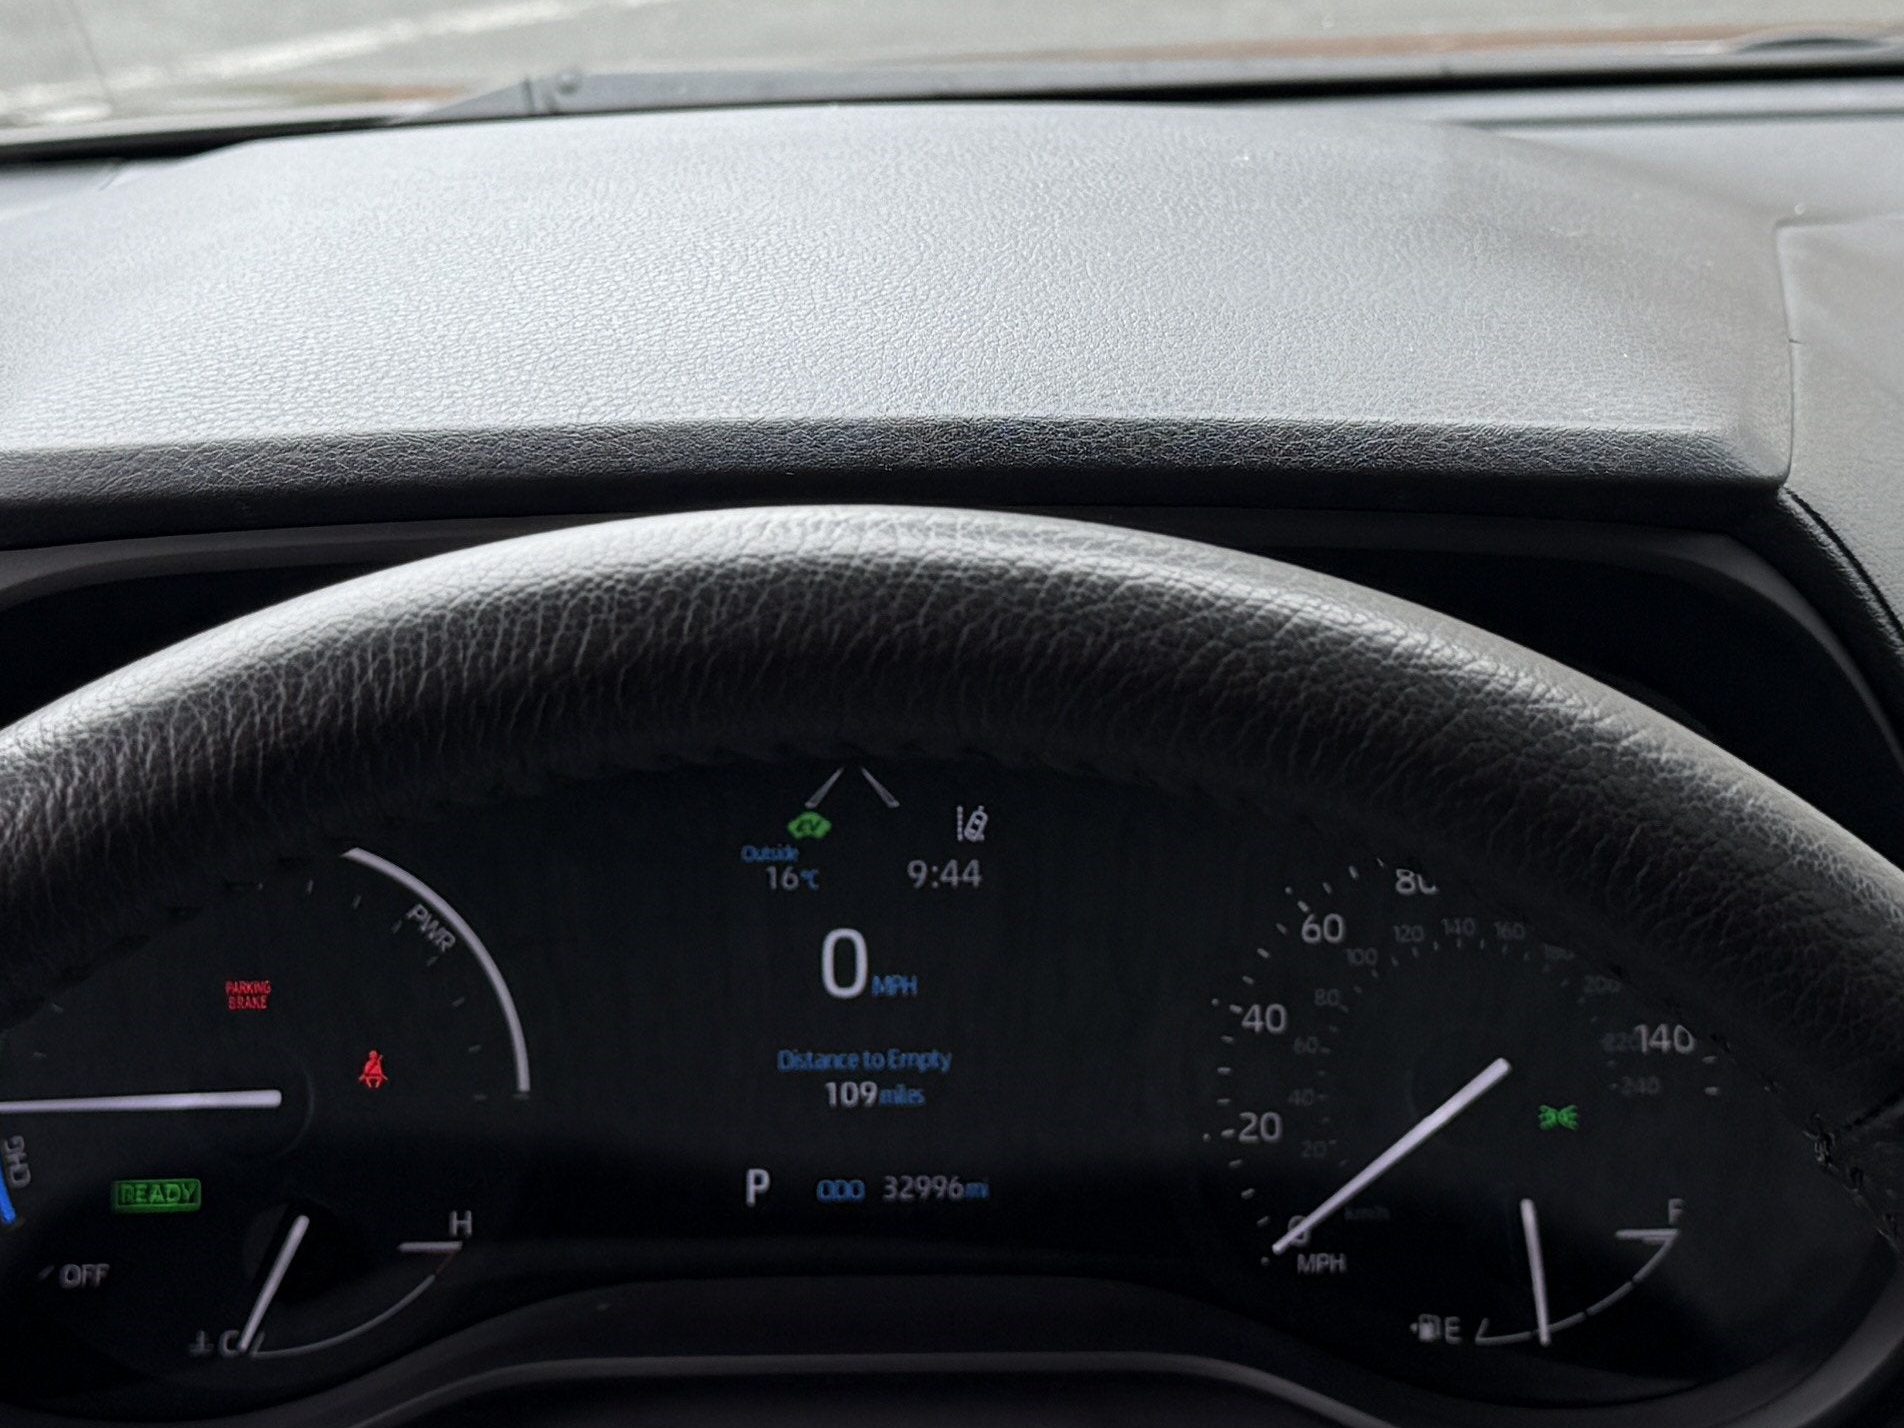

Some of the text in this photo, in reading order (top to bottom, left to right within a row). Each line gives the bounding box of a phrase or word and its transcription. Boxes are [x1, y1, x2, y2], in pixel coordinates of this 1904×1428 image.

[741, 845, 800, 863] Outside
[907, 859, 982, 888] 9:44
[408, 904, 457, 953] PWR
[1300, 912, 1346, 945] 60
[822, 929, 918, 998] 0 MPH
[225, 981, 271, 995] PARKING
[228, 996, 267, 1010] BRAKE
[1241, 1003, 1287, 1034] 40
[1635, 1023, 1695, 1054] 140
[777, 1049, 953, 1074] Distance to Empty
[825, 1081, 925, 1108] 109 miles
[1239, 1111, 1283, 1142] 20
[3, 1135, 31, 1189] CHG
[119, 1182, 197, 1205] READY
[747, 1169, 770, 1204] P
[882, 1176, 965, 1200] 32996
[1668, 1198, 1684, 1222] F
[450, 1212, 472, 1237] H
[59, 1264, 109, 1288] OFF
[1297, 1253, 1347, 1274] MPH
[1445, 1318, 1462, 1342] E
